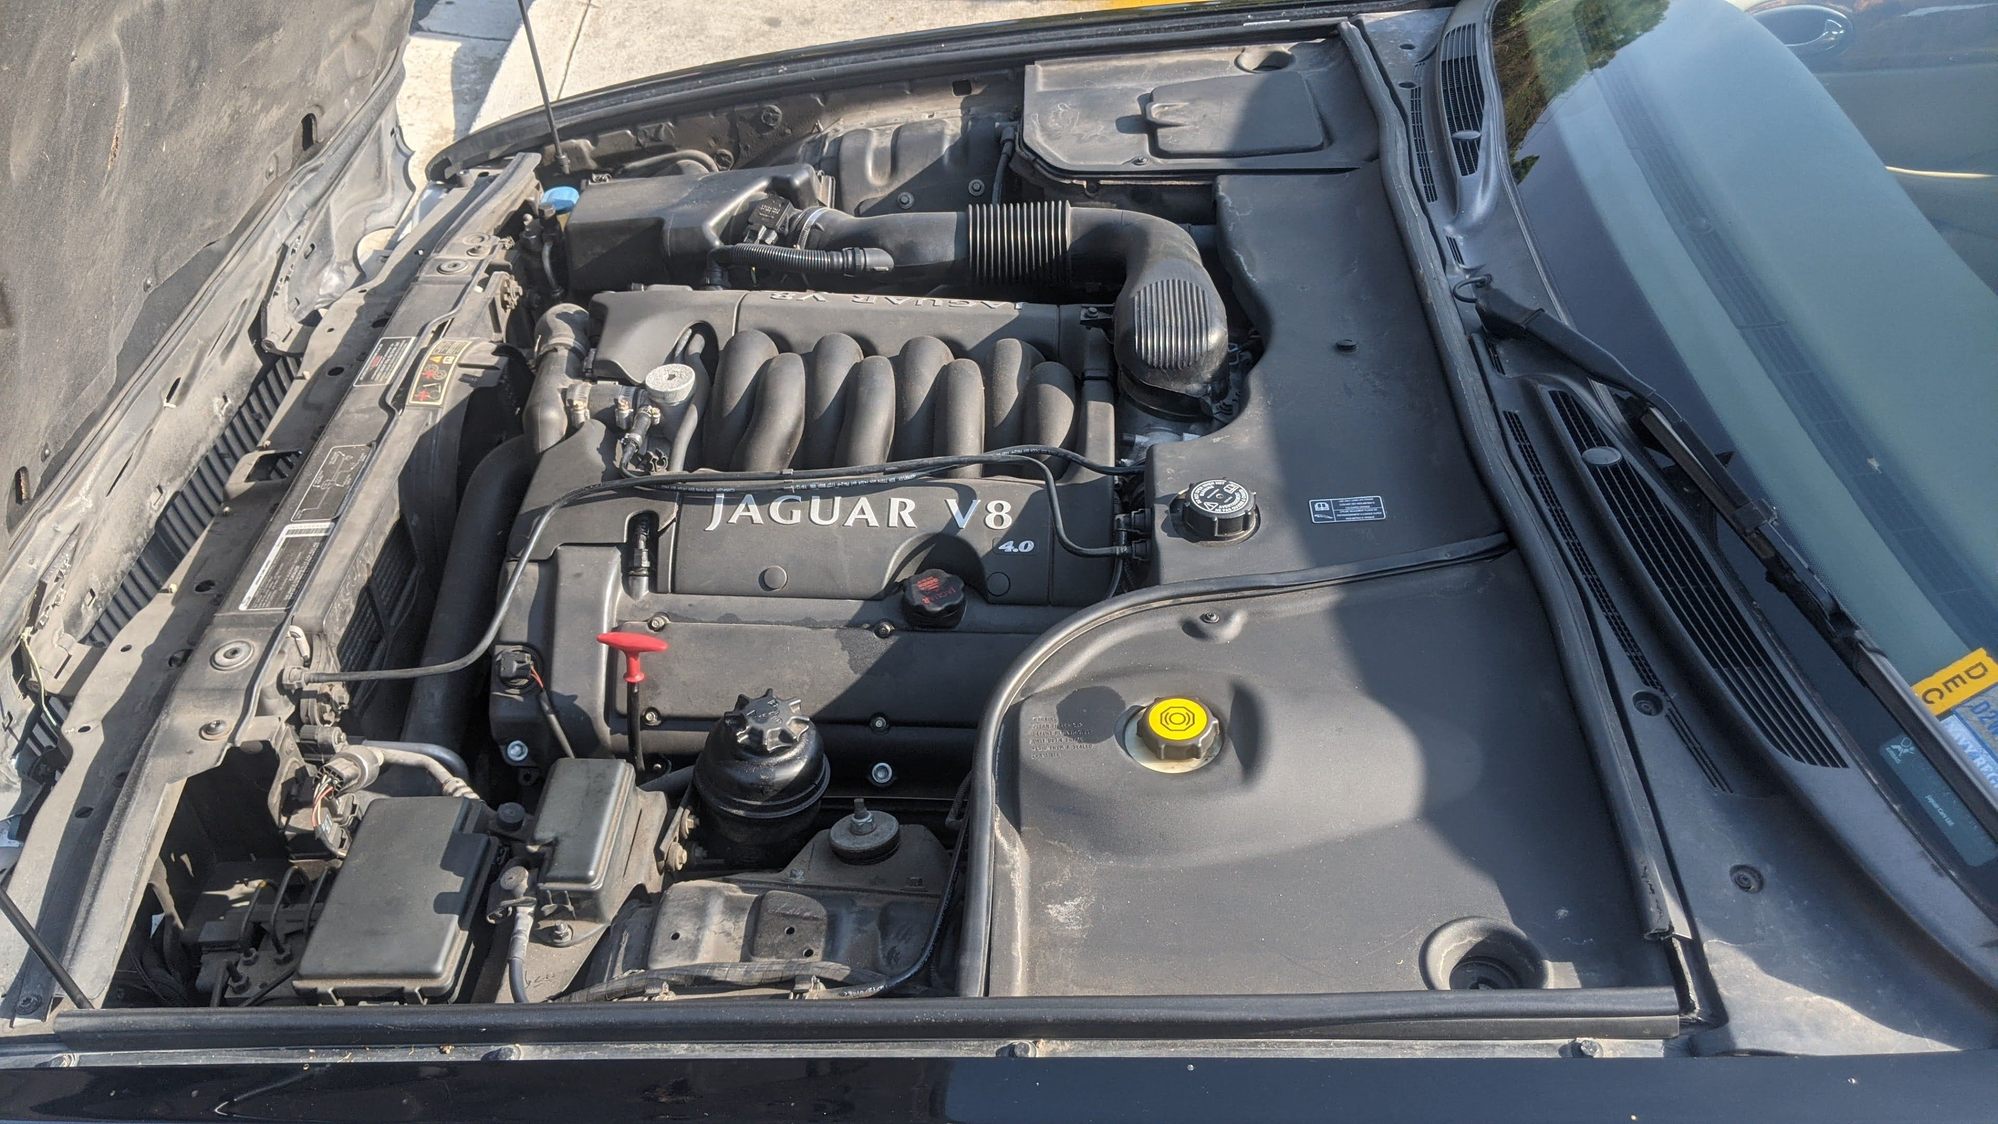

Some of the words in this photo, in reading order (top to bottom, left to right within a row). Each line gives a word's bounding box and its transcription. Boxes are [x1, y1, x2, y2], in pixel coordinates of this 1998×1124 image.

[704, 493, 917, 532] JAGUAR
[945, 497, 1013, 531] V8
[998, 539, 1036, 554] 4.0
[1921, 661, 1988, 705] DEC
